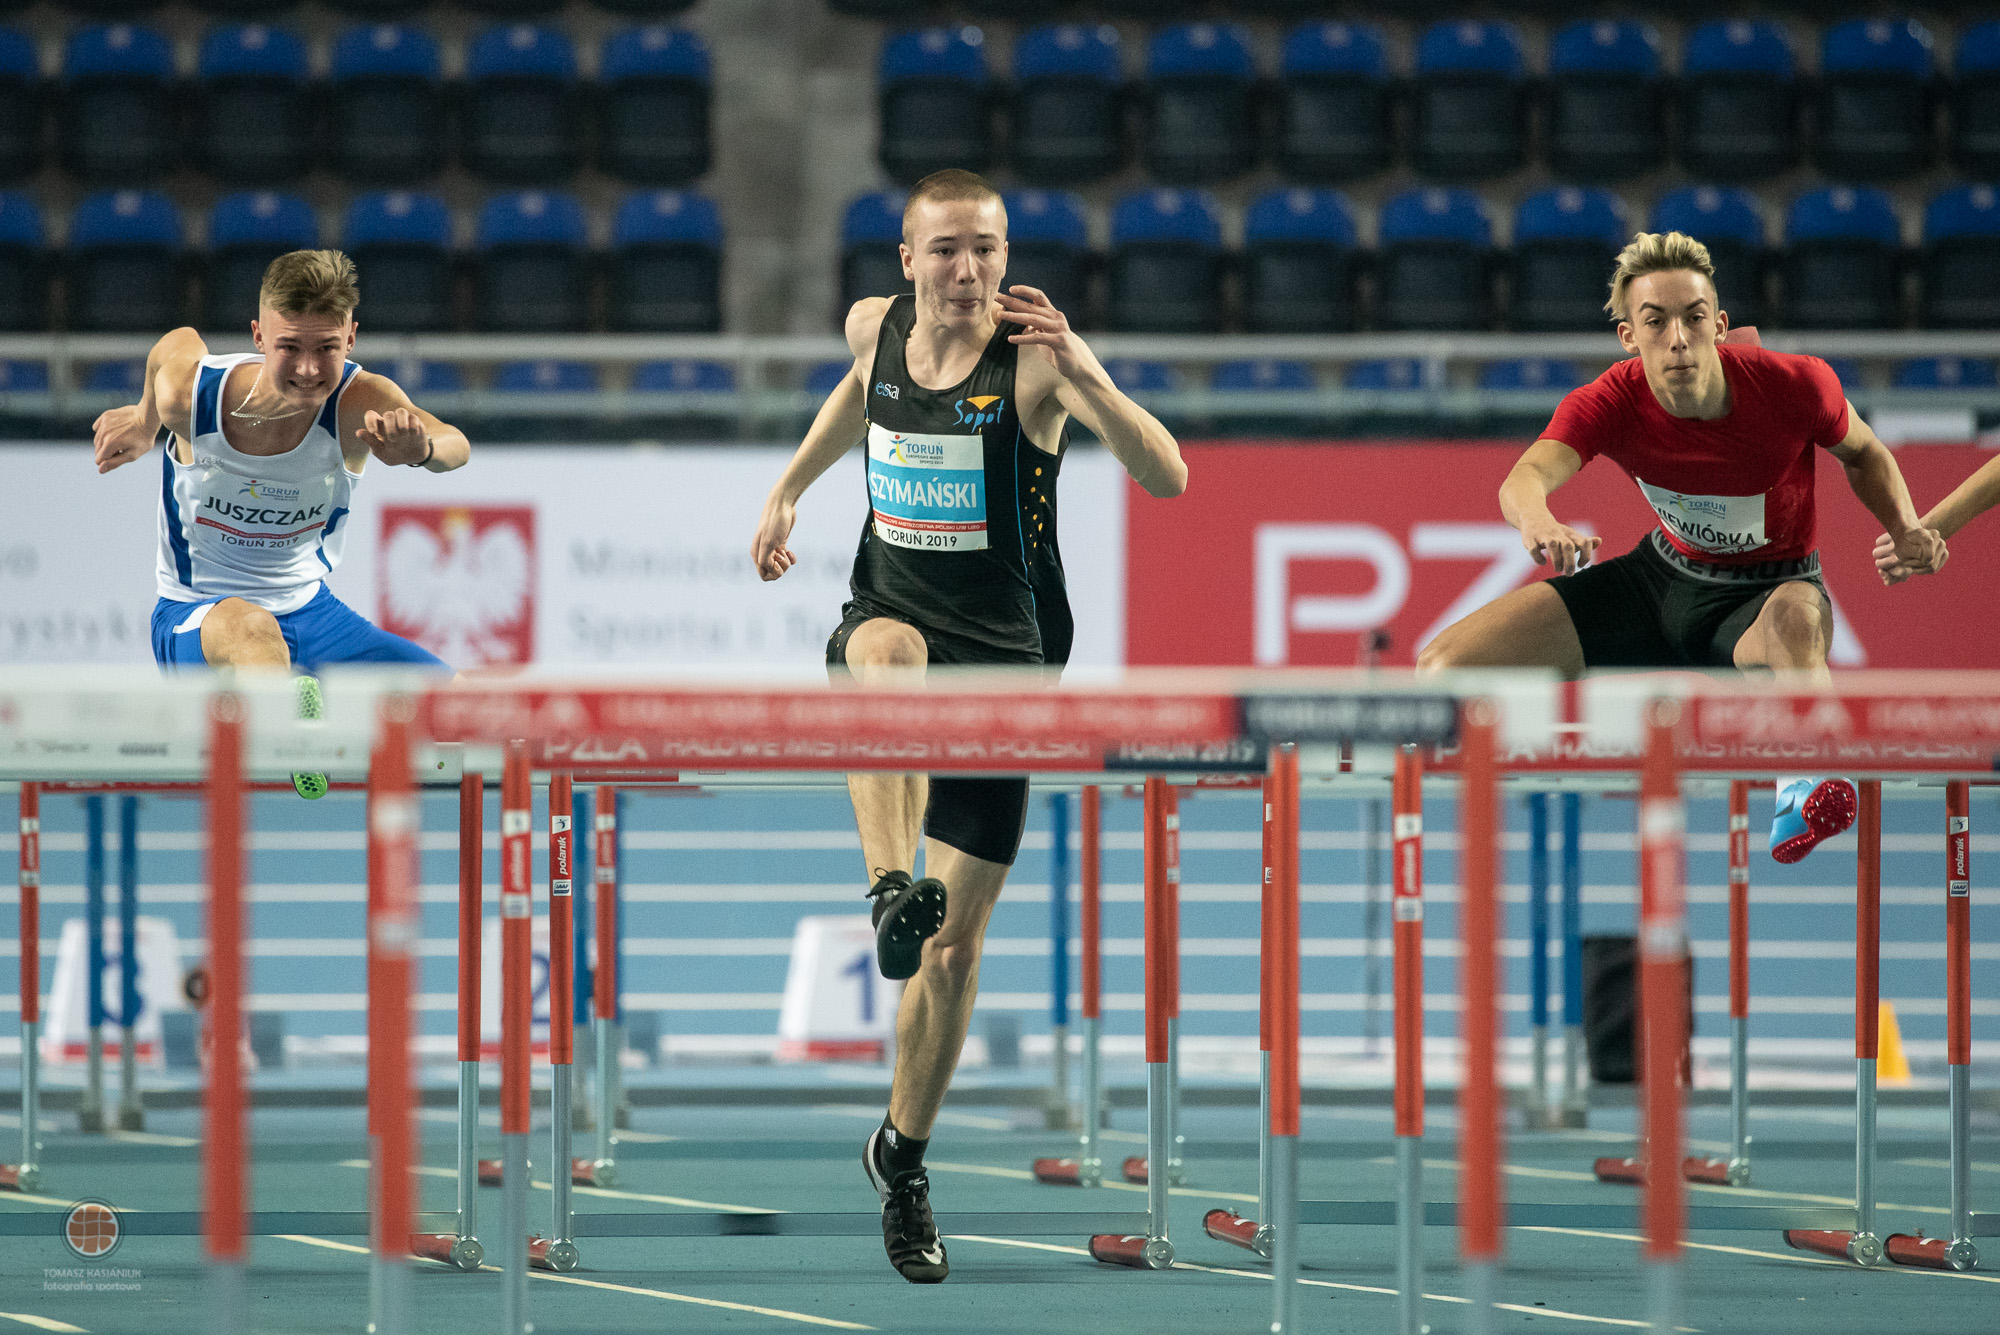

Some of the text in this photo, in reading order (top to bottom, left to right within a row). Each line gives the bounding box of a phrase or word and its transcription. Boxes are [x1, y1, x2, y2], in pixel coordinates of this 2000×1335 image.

[953, 399, 1005, 433] Sopot
[905, 441, 944, 455] TORUŃ
[262, 485, 300, 496] TORUŃ
[870, 471, 977, 508] SZYMAŃSKI
[204, 496, 326, 526] JUSZCZAK
[1688, 501, 1726, 513] TORUŃ
[221, 533, 299, 548] TORUŃ 2019
[886, 528, 958, 547] TORUŃ 2019
[557, 836, 569, 876] polanik
[1956, 838, 1966, 876] polanik
[842, 951, 878, 1025] 1
